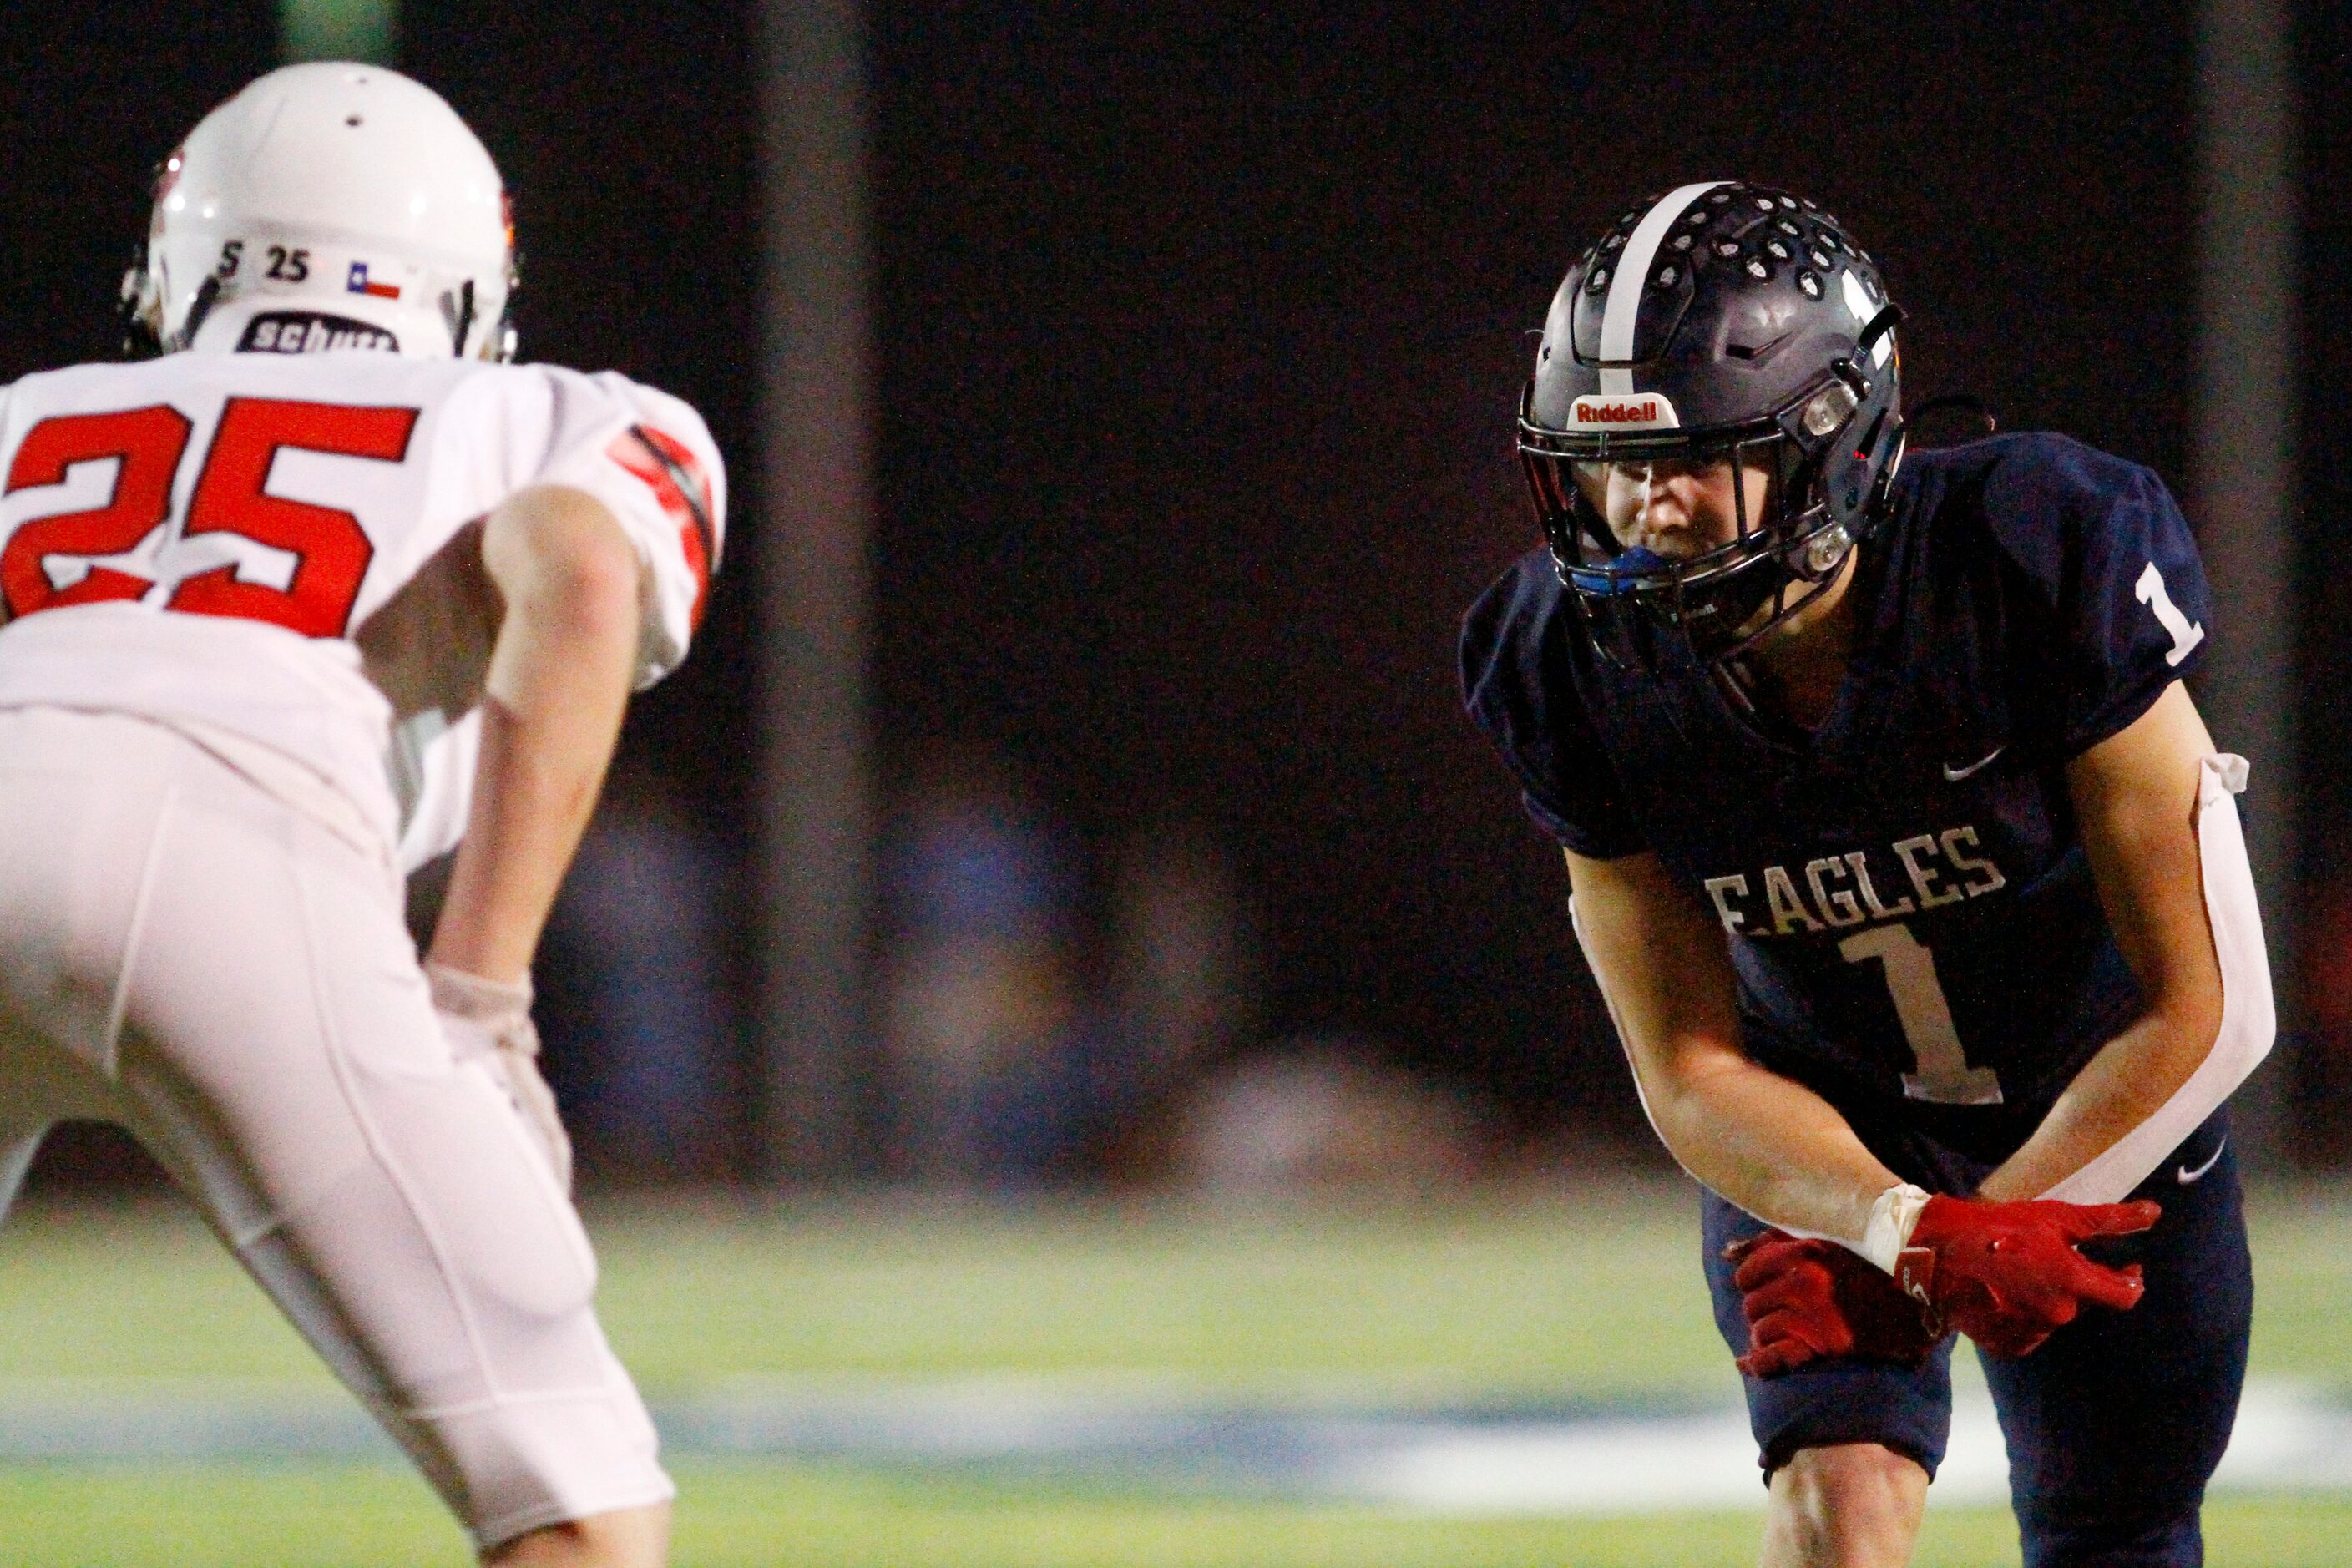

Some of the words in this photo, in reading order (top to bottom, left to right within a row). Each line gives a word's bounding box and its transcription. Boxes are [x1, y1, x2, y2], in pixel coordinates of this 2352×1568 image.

[266, 245, 310, 281] 25
[1577, 402, 1657, 422] Riddell
[0, 396, 421, 638] 25
[2135, 562, 2205, 667] 1
[1704, 826, 2006, 935] EAGLES
[1839, 923, 2004, 1104] 1
